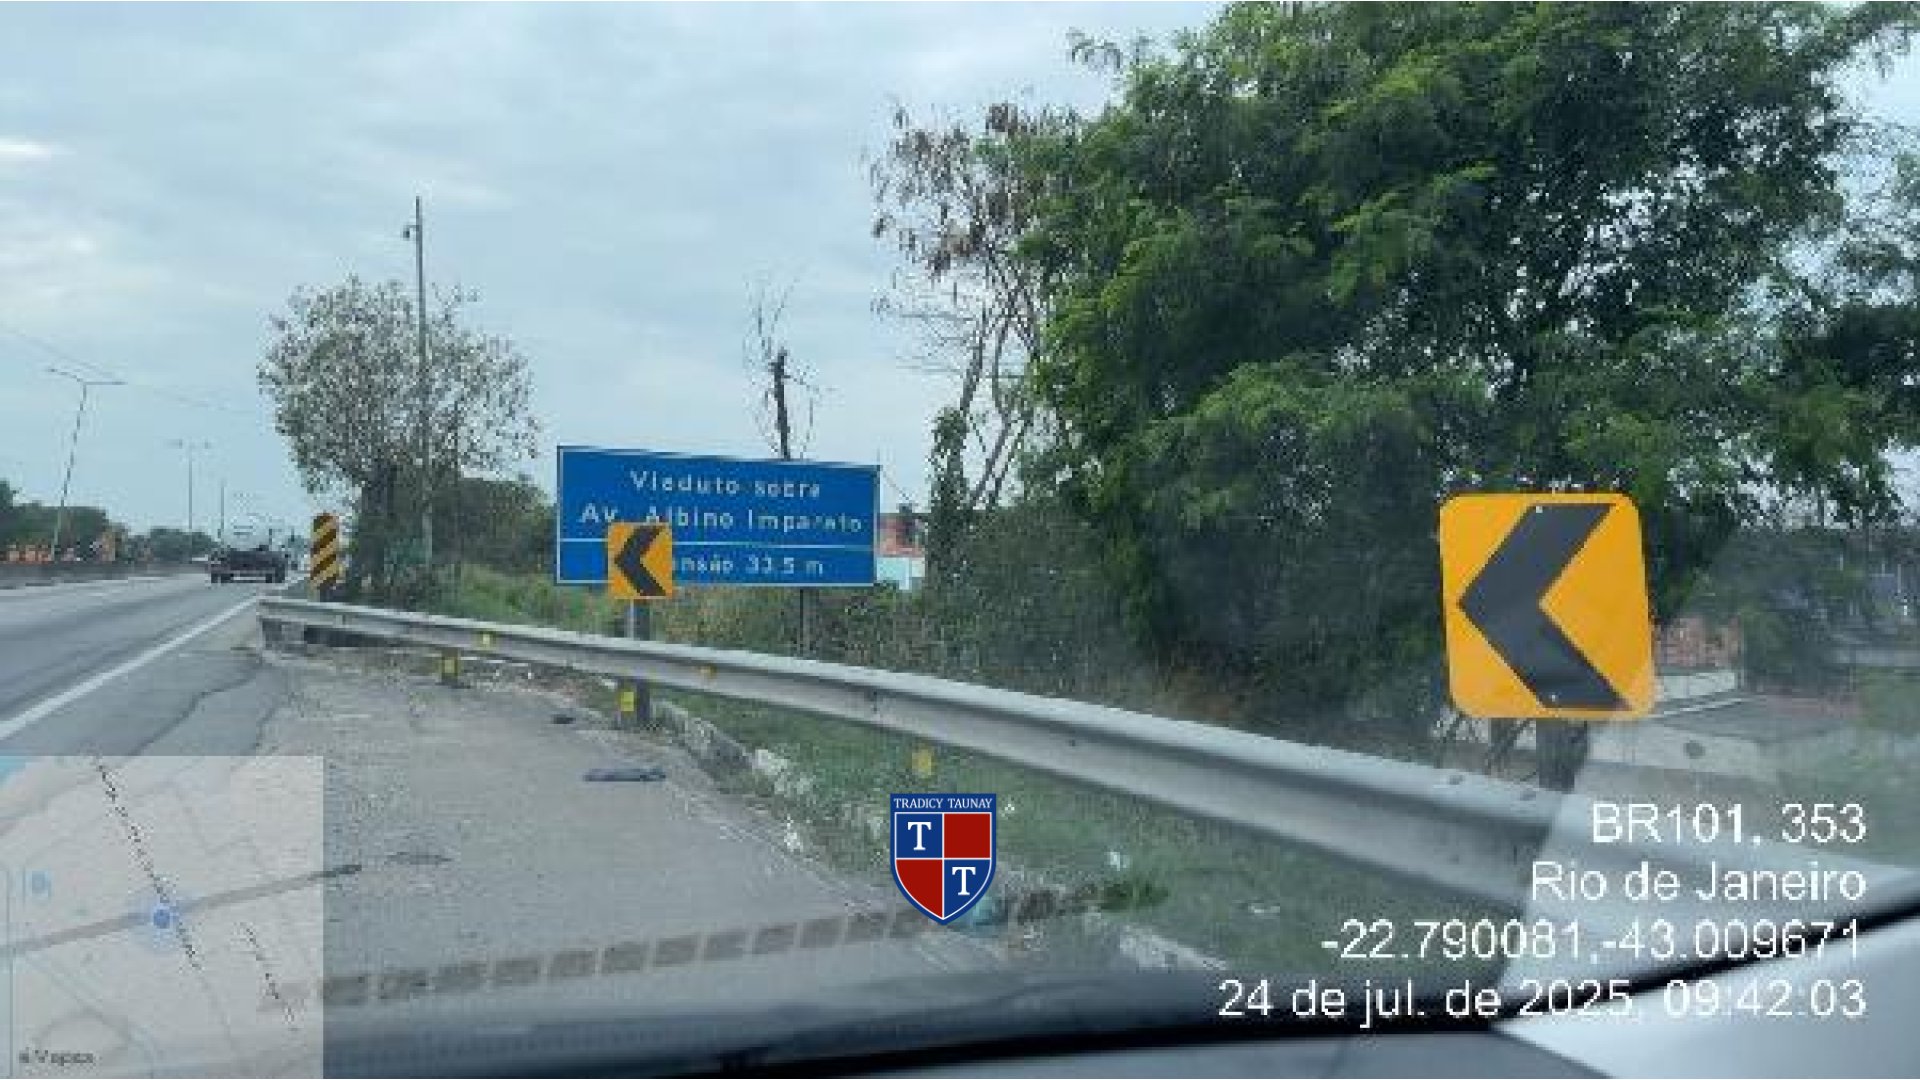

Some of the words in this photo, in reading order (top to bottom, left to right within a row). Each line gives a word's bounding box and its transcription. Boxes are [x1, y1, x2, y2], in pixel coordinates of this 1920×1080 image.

[629, 469, 741, 496] Viaduto
[754, 478, 821, 499] sobre
[645, 504, 734, 531] Albino
[747, 509, 863, 534] Imparato
[805, 560, 824, 576] m
